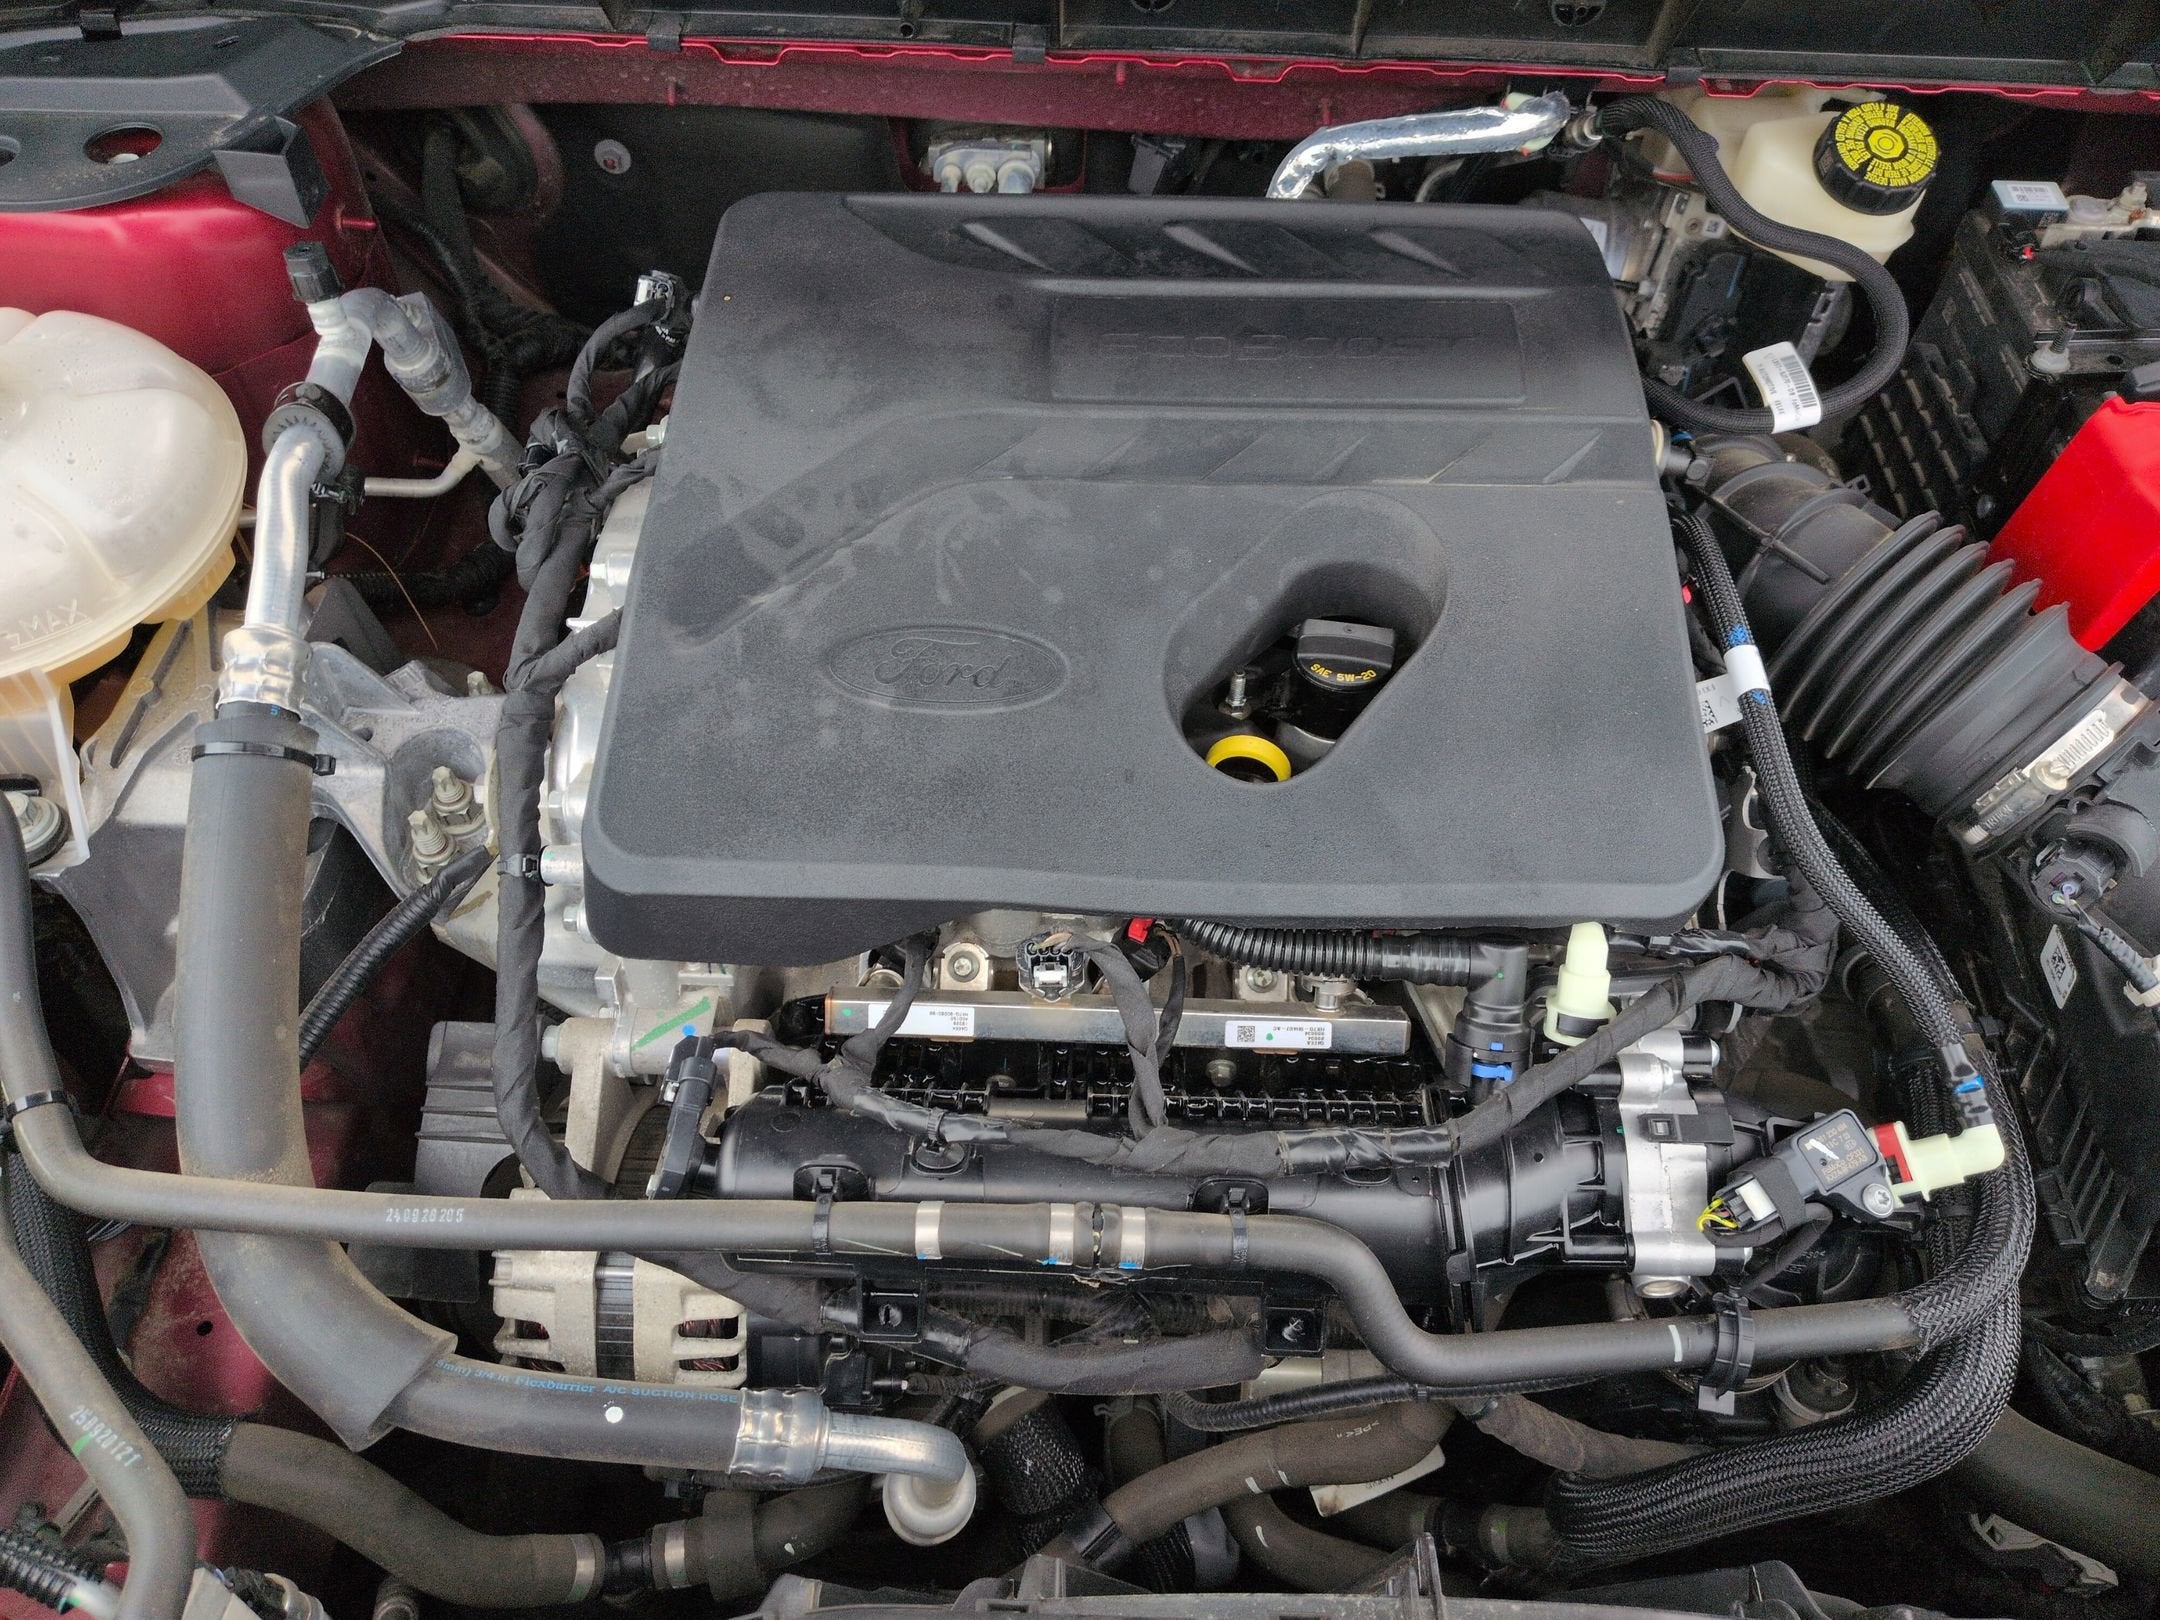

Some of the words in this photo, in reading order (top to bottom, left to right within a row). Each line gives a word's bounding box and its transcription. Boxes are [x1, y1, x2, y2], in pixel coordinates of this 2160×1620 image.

[873, 636, 1013, 690] Ford
[1310, 663, 1332, 678] SAE
[1336, 669, 1377, 682] 5W-20
[603, 1385, 626, 1394] A/C
[631, 1387, 695, 1399] SUCTION
[698, 1393, 738, 1404] HOSE
